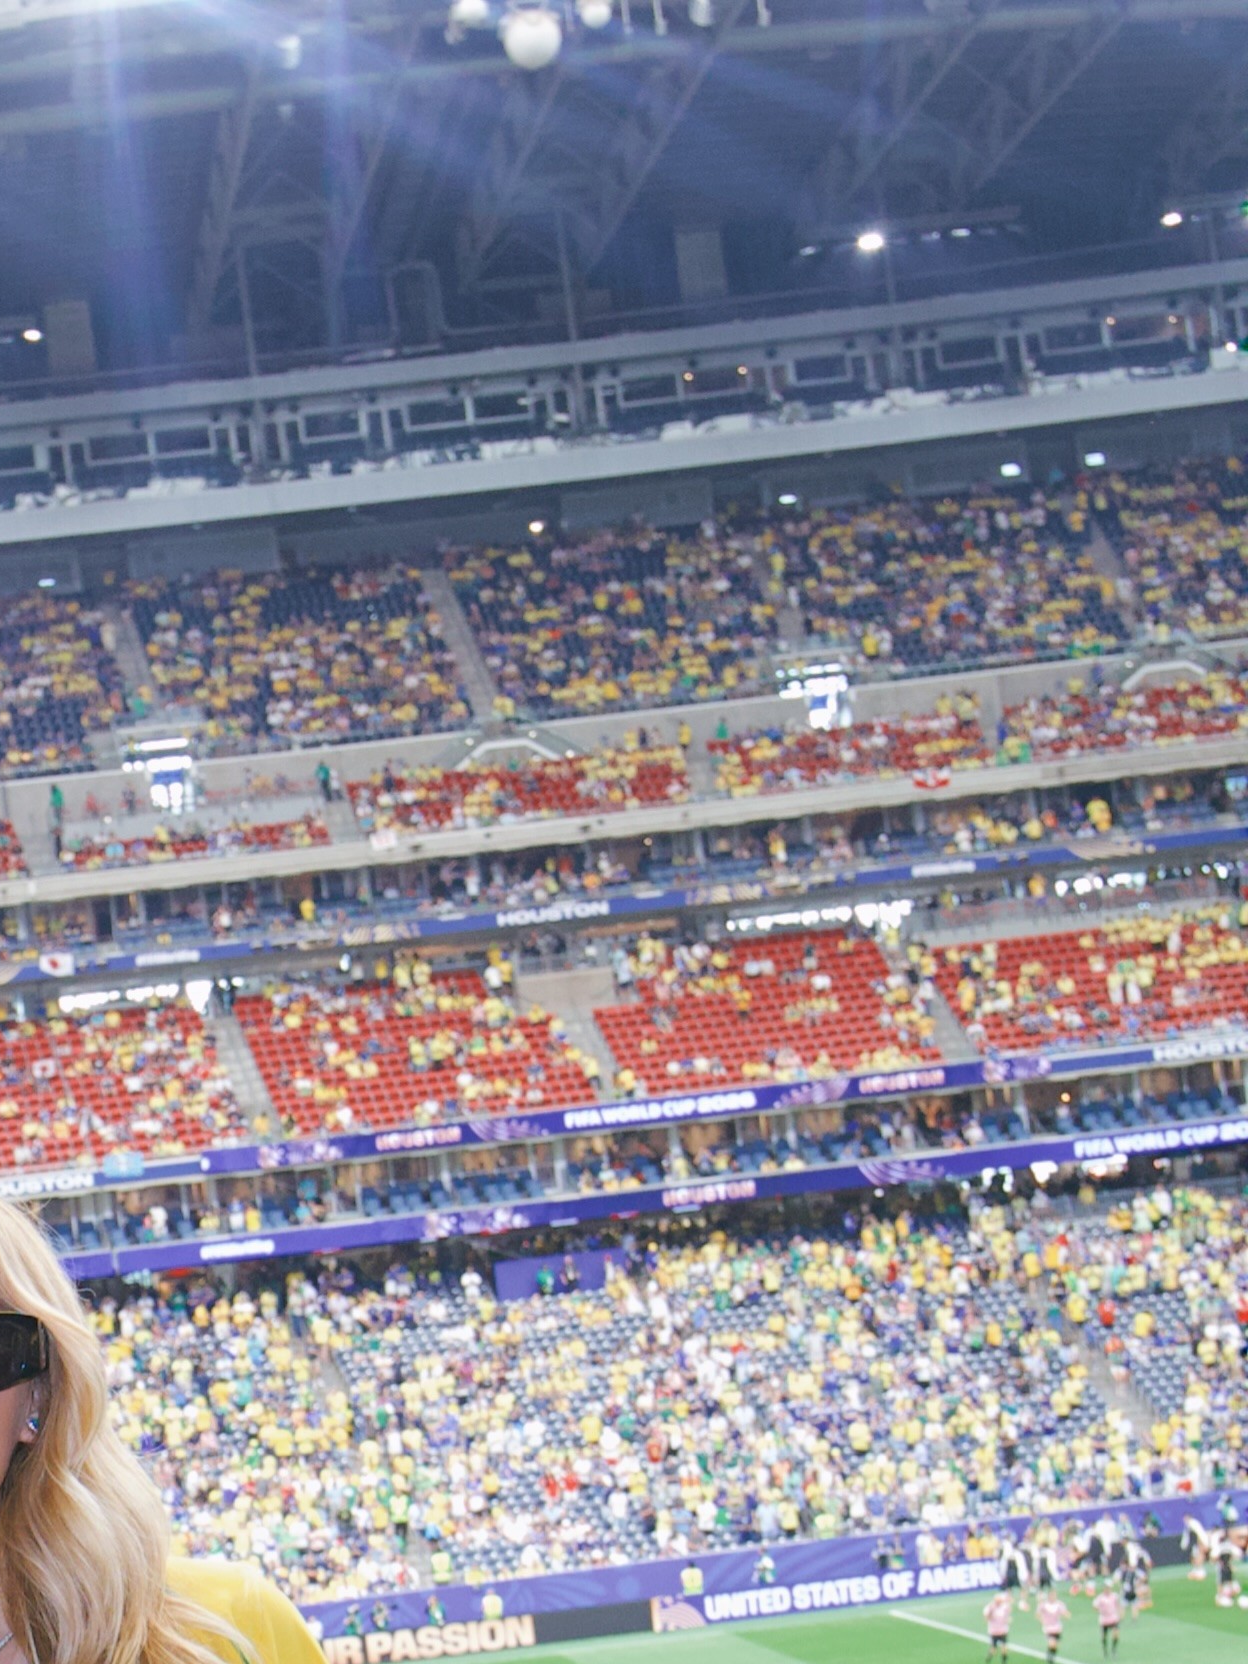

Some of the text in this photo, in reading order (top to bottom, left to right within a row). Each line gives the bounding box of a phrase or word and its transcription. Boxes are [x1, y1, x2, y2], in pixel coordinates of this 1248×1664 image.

[497, 900, 610, 927] HOUSTON
[859, 1069, 945, 1093] HOUSTON
[564, 1109, 602, 1129] FIFA
[602, 1102, 663, 1124] WORLD
[663, 1098, 696, 1117] CUP
[376, 1127, 461, 1151] HOUSTON
[1074, 1139, 1113, 1158] FIFA
[1113, 1131, 1180, 1153] WORLD
[1181, 1125, 1218, 1145] CUP
[662, 1181, 756, 1207] HOUSTON
[704, 1584, 792, 1620] UNITED
[793, 1576, 880, 1609] STATES
[882, 1570, 915, 1599] OF
[365, 1614, 536, 1664] PASSION
